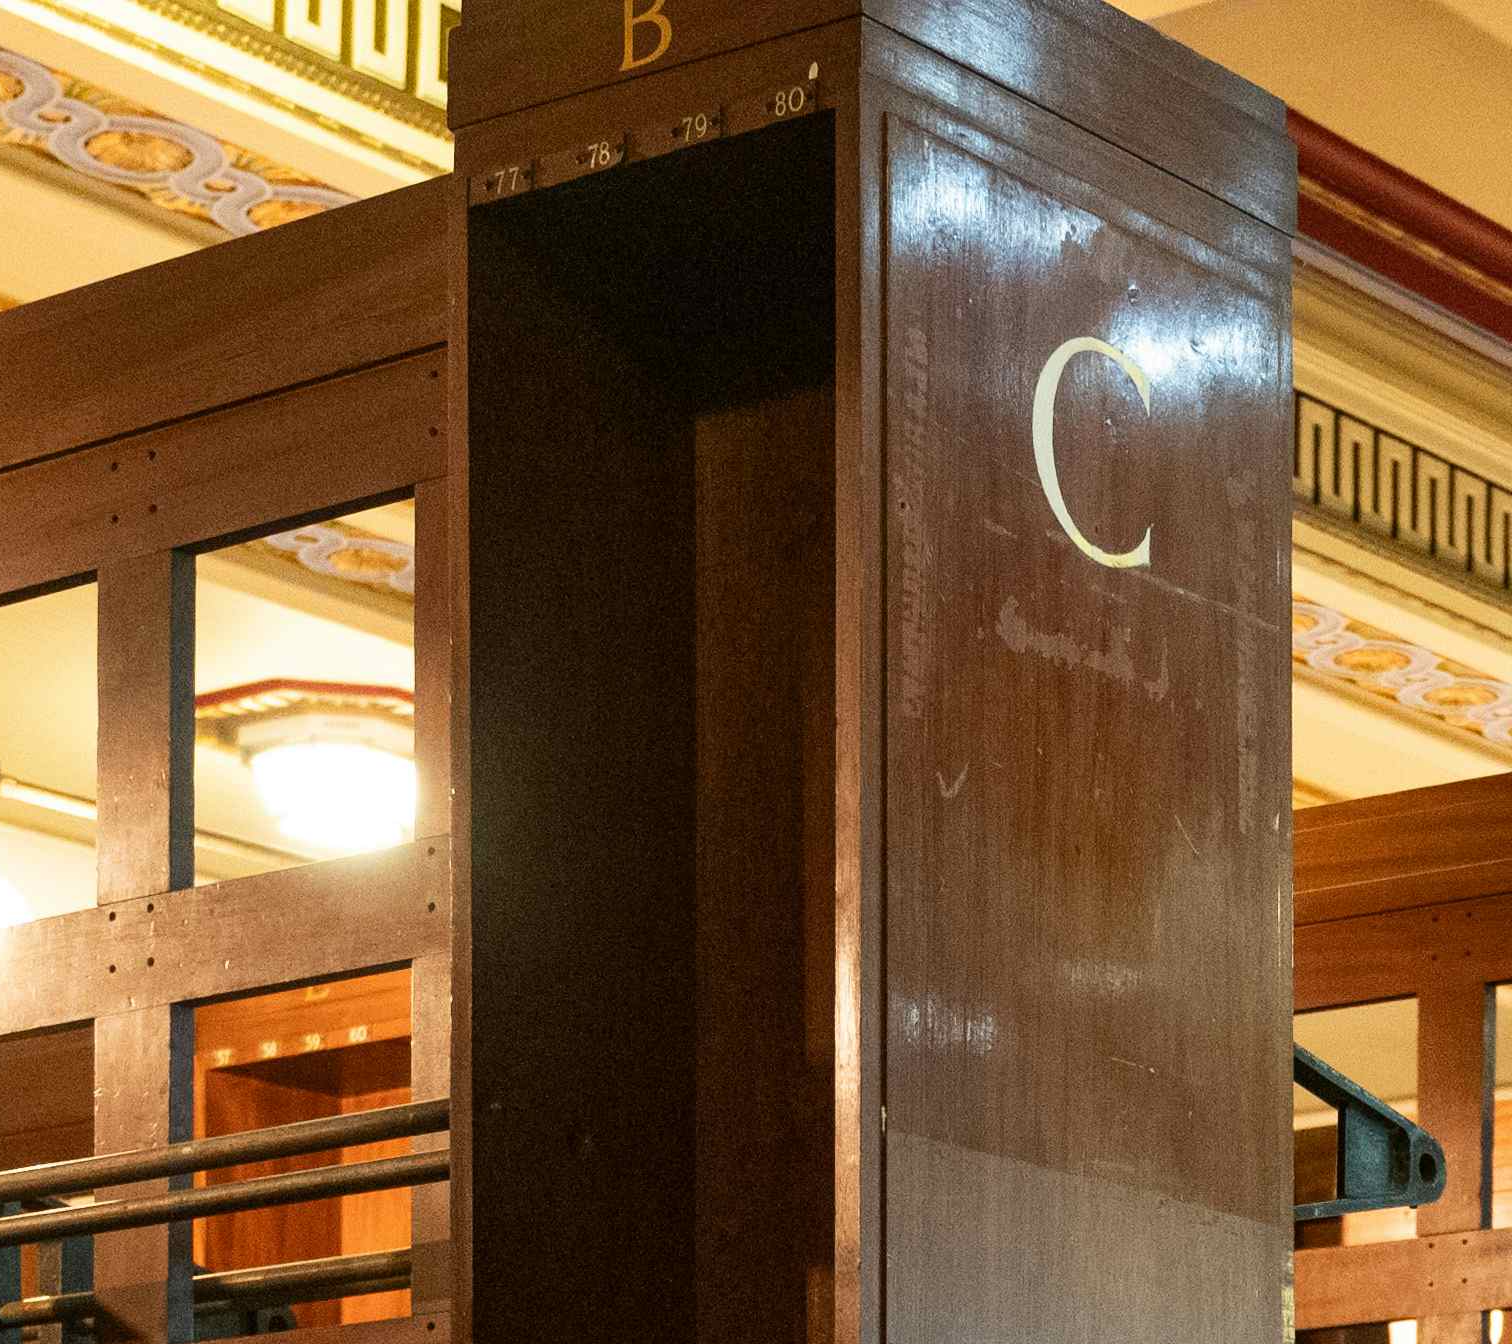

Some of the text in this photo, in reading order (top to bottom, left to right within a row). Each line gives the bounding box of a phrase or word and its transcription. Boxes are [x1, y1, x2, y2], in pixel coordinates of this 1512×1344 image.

[620, 0, 672, 71] B
[495, 87, 804, 195] 77 78 79 80
[1033, 336, 1151, 568] C
